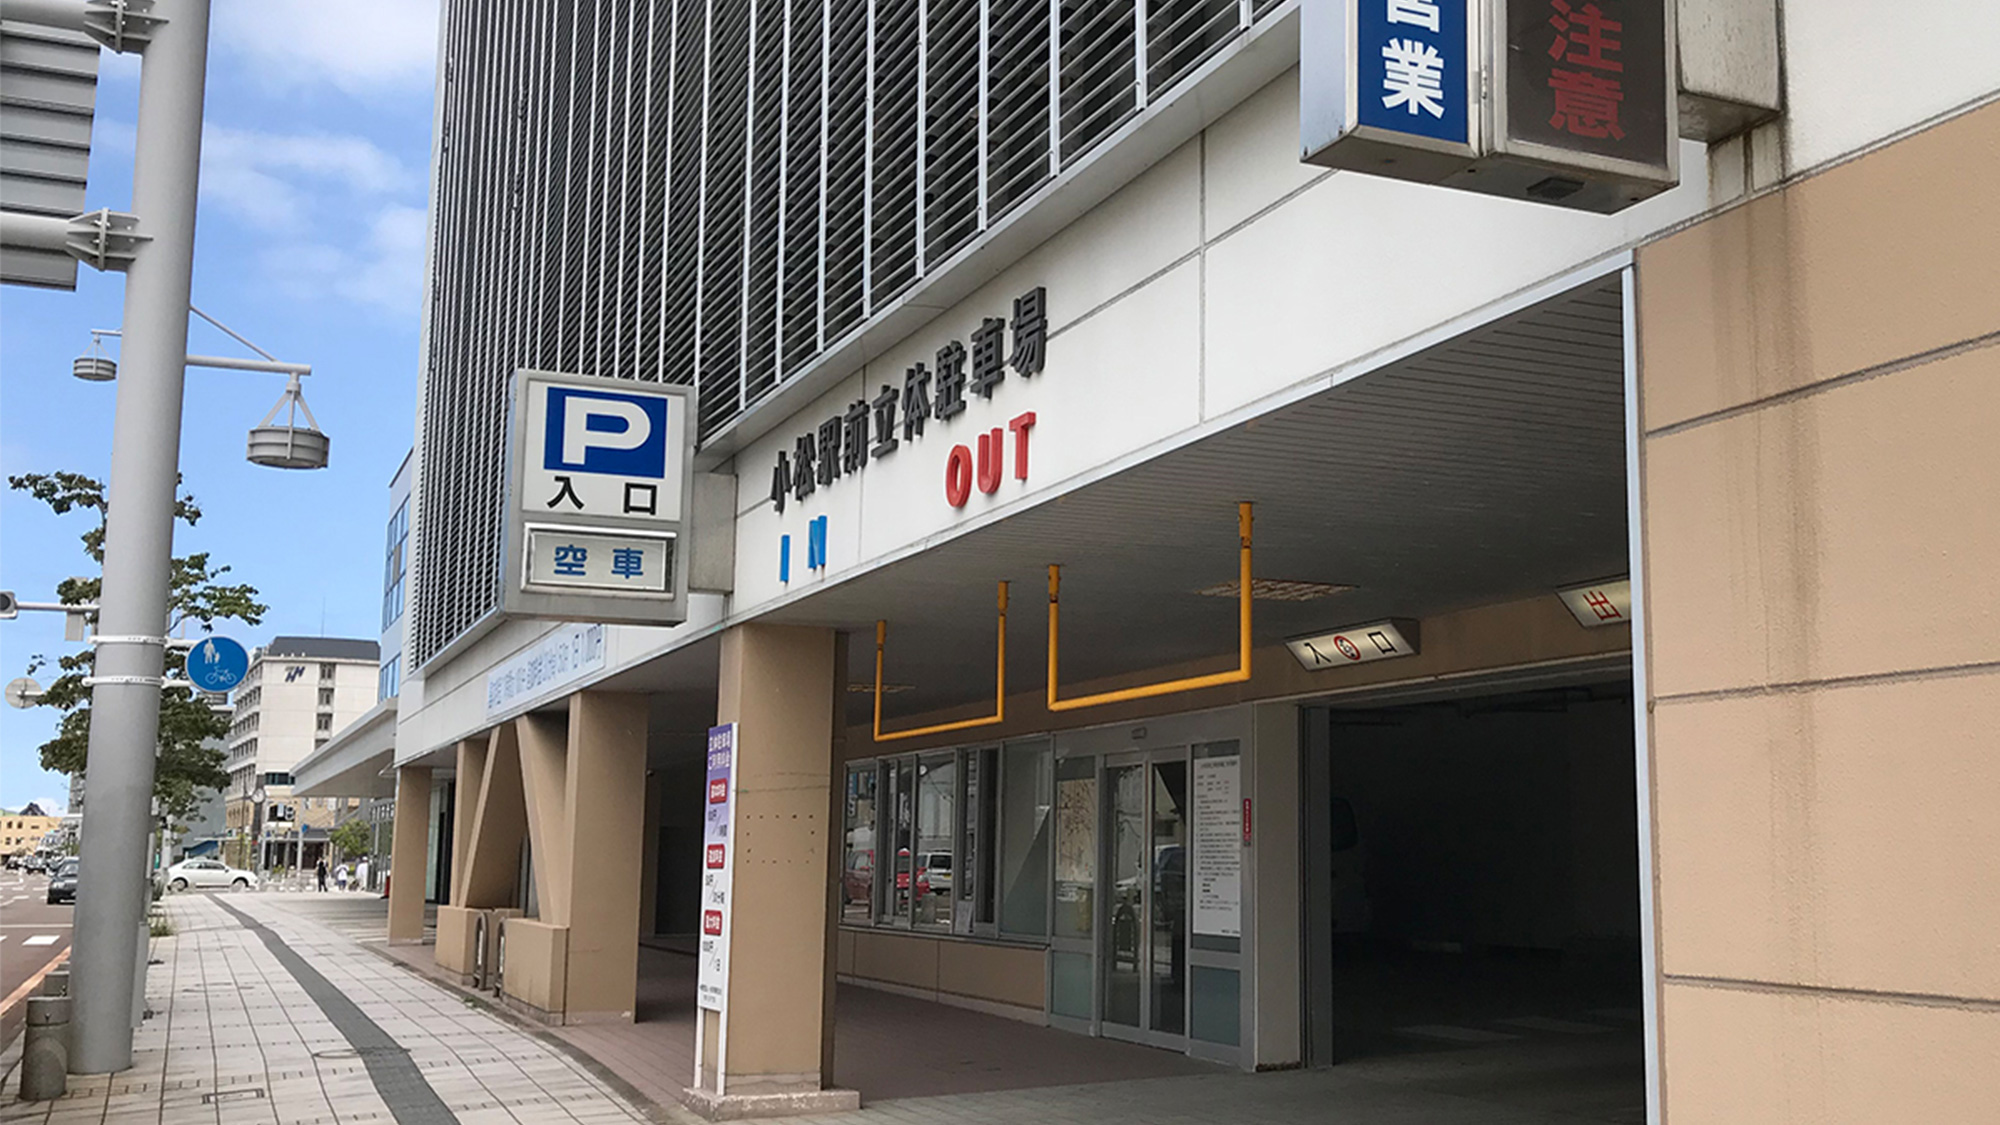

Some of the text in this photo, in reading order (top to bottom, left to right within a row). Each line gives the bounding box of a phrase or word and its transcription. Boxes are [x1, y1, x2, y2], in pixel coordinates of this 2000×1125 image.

[1548, 0, 1626, 140] 注意
[562, 396, 651, 465] P
[770, 286, 1048, 514] 小松駅前立体駐車場
[946, 411, 1036, 508] OUT
[547, 476, 657, 515] 入口
[554, 544, 644, 579] 空車
[780, 515, 827, 583] IN
[1582, 590, 1623, 621] 出
